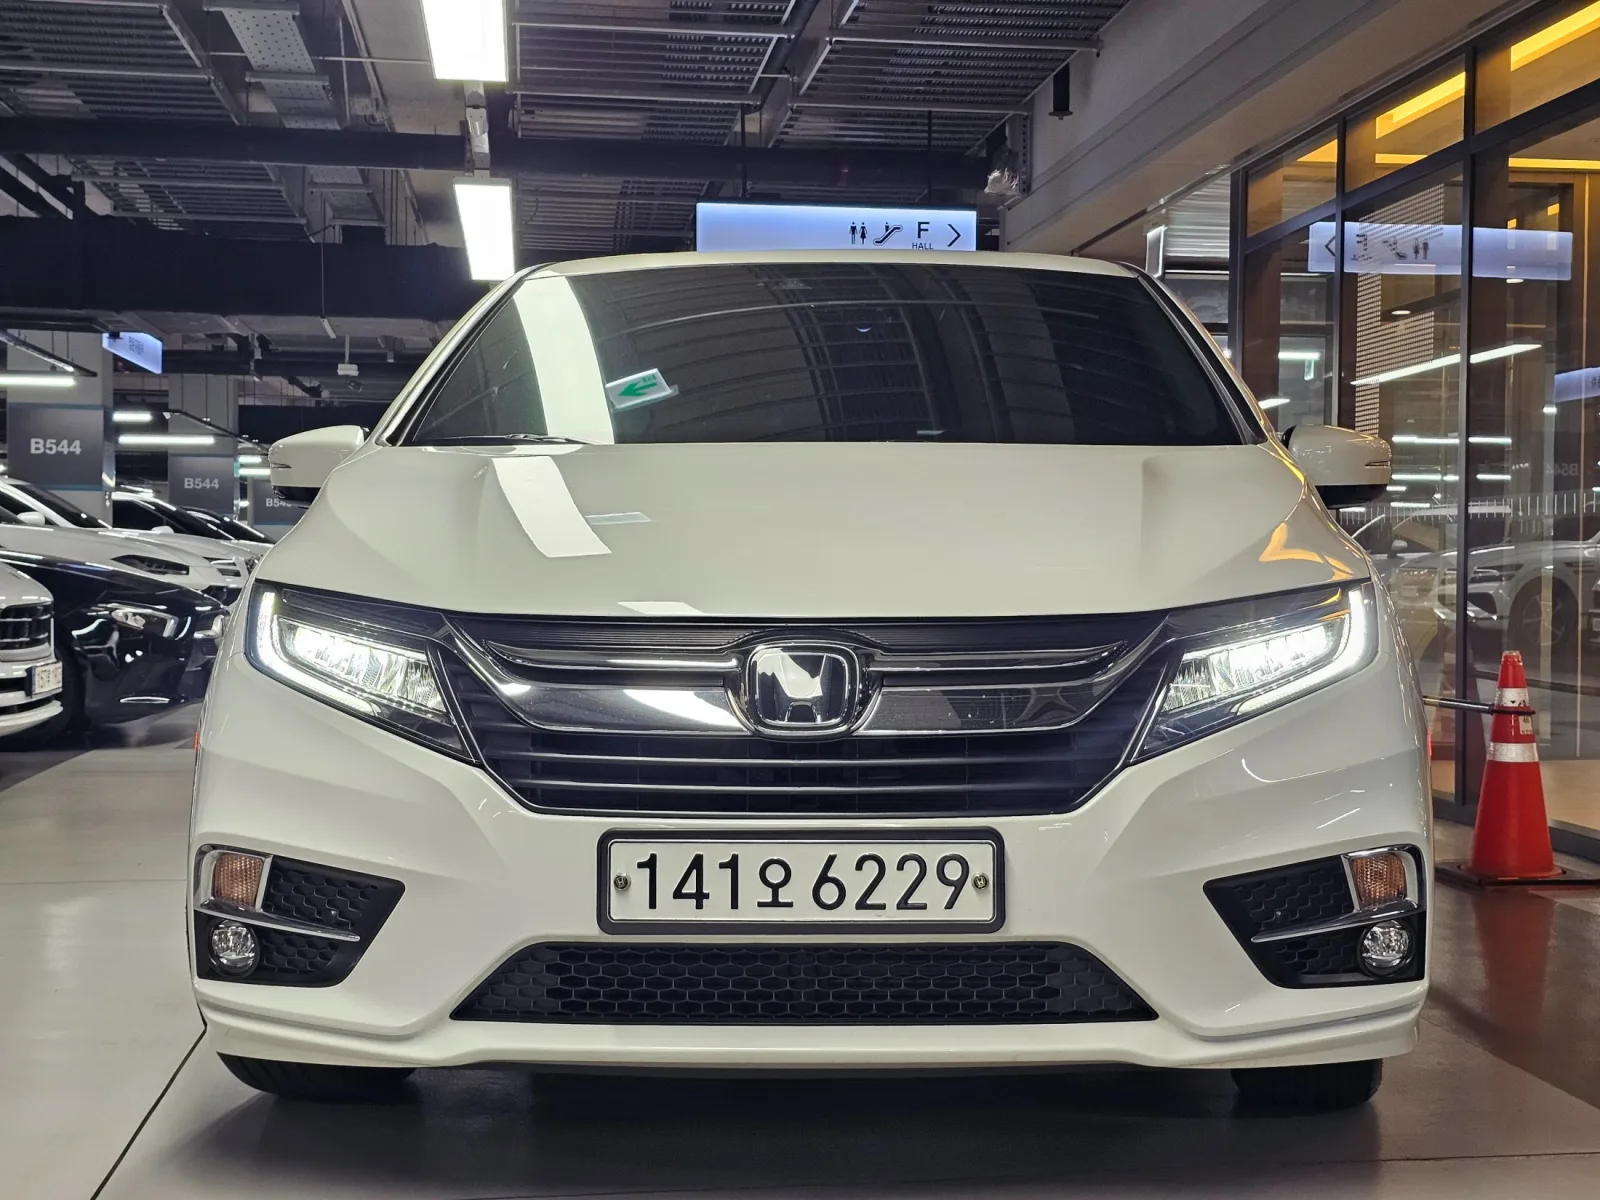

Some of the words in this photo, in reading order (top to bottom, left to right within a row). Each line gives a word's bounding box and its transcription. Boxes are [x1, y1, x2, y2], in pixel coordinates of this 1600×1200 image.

[917, 221, 930, 239] F
[911, 242, 934, 250] HALL
[30, 437, 82, 455] B544
[183, 478, 219, 489] B544
[265, 498, 292, 507] B5
[811, 853, 970, 911] 6229
